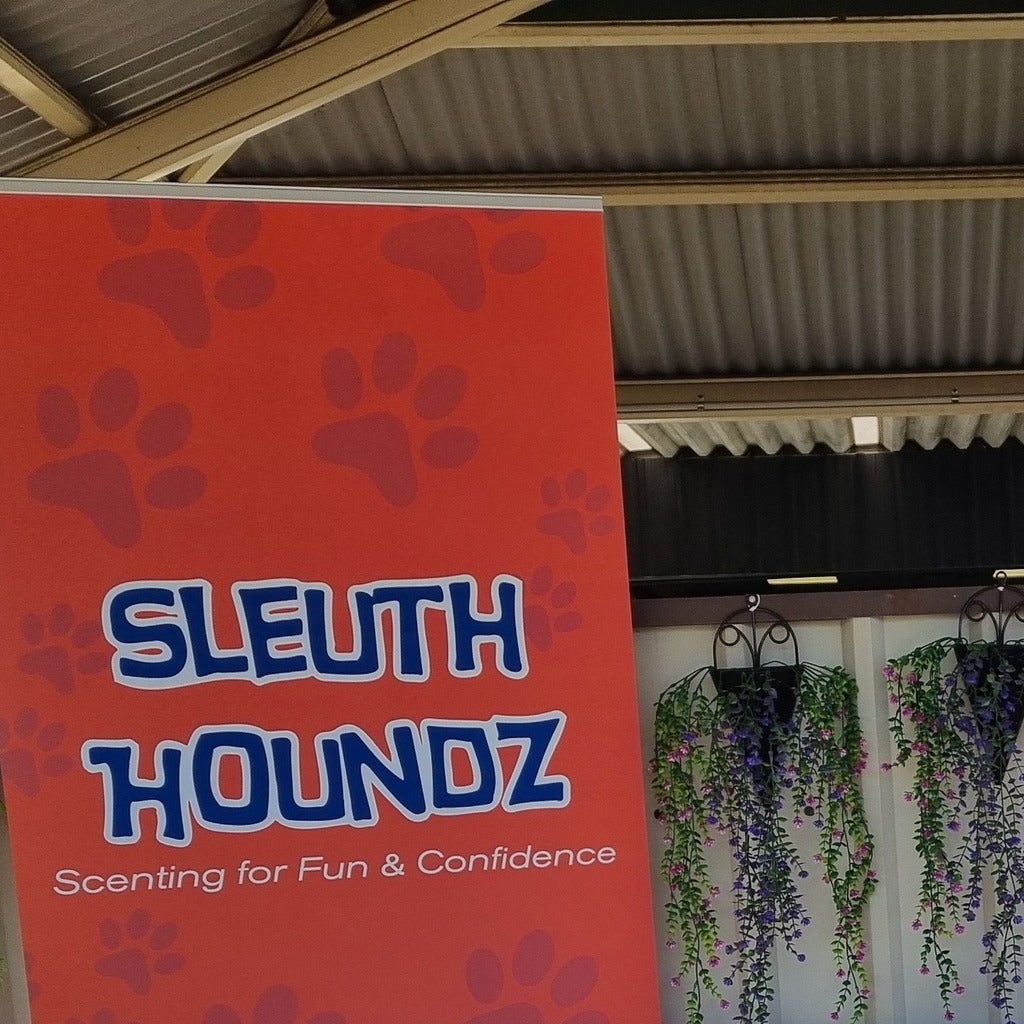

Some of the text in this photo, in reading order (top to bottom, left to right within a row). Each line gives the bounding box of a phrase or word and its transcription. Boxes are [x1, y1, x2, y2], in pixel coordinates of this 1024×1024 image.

[102, 575, 528, 689] SLEUTH
[82, 711, 569, 846] HOUNDZ
[53, 842, 617, 896] Scenting for Fun & Confidence
